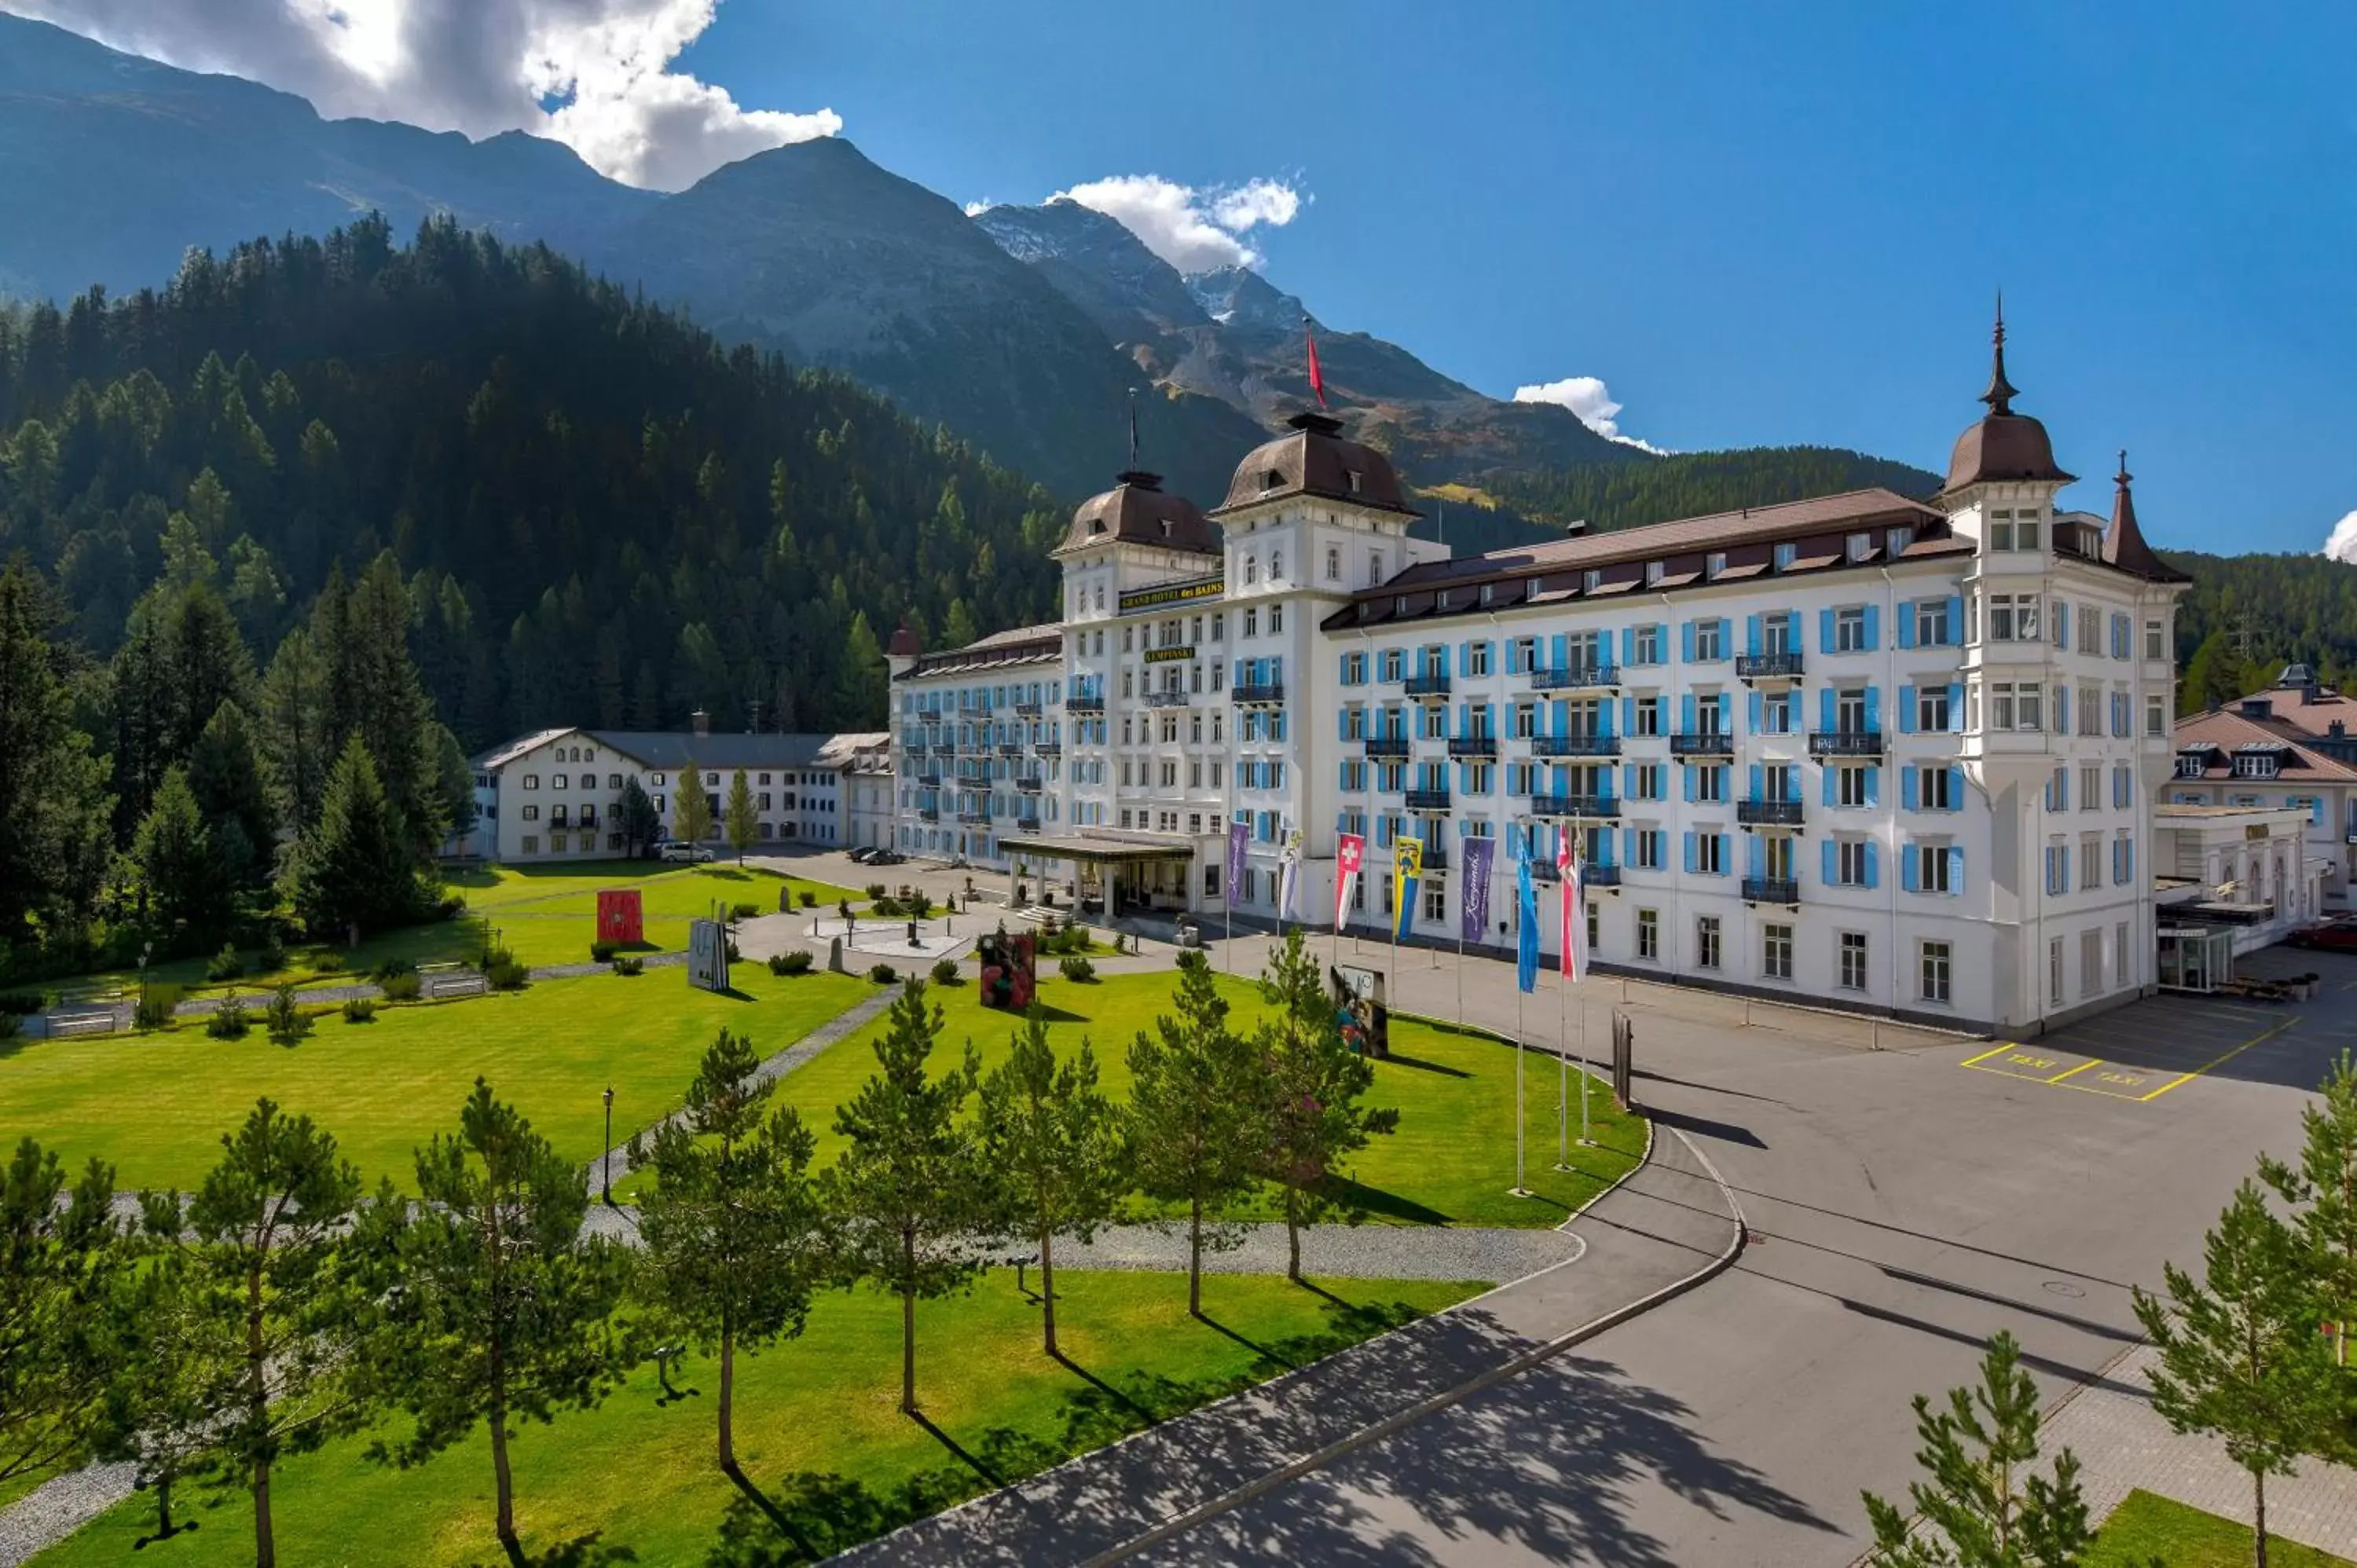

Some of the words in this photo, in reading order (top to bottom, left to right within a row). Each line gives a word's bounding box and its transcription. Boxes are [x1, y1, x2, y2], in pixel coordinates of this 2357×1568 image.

[1196, 583, 1223, 595] BAINS
[2007, 1054, 2056, 1068] TAXI
[2096, 1072, 2146, 1086] TAXI
